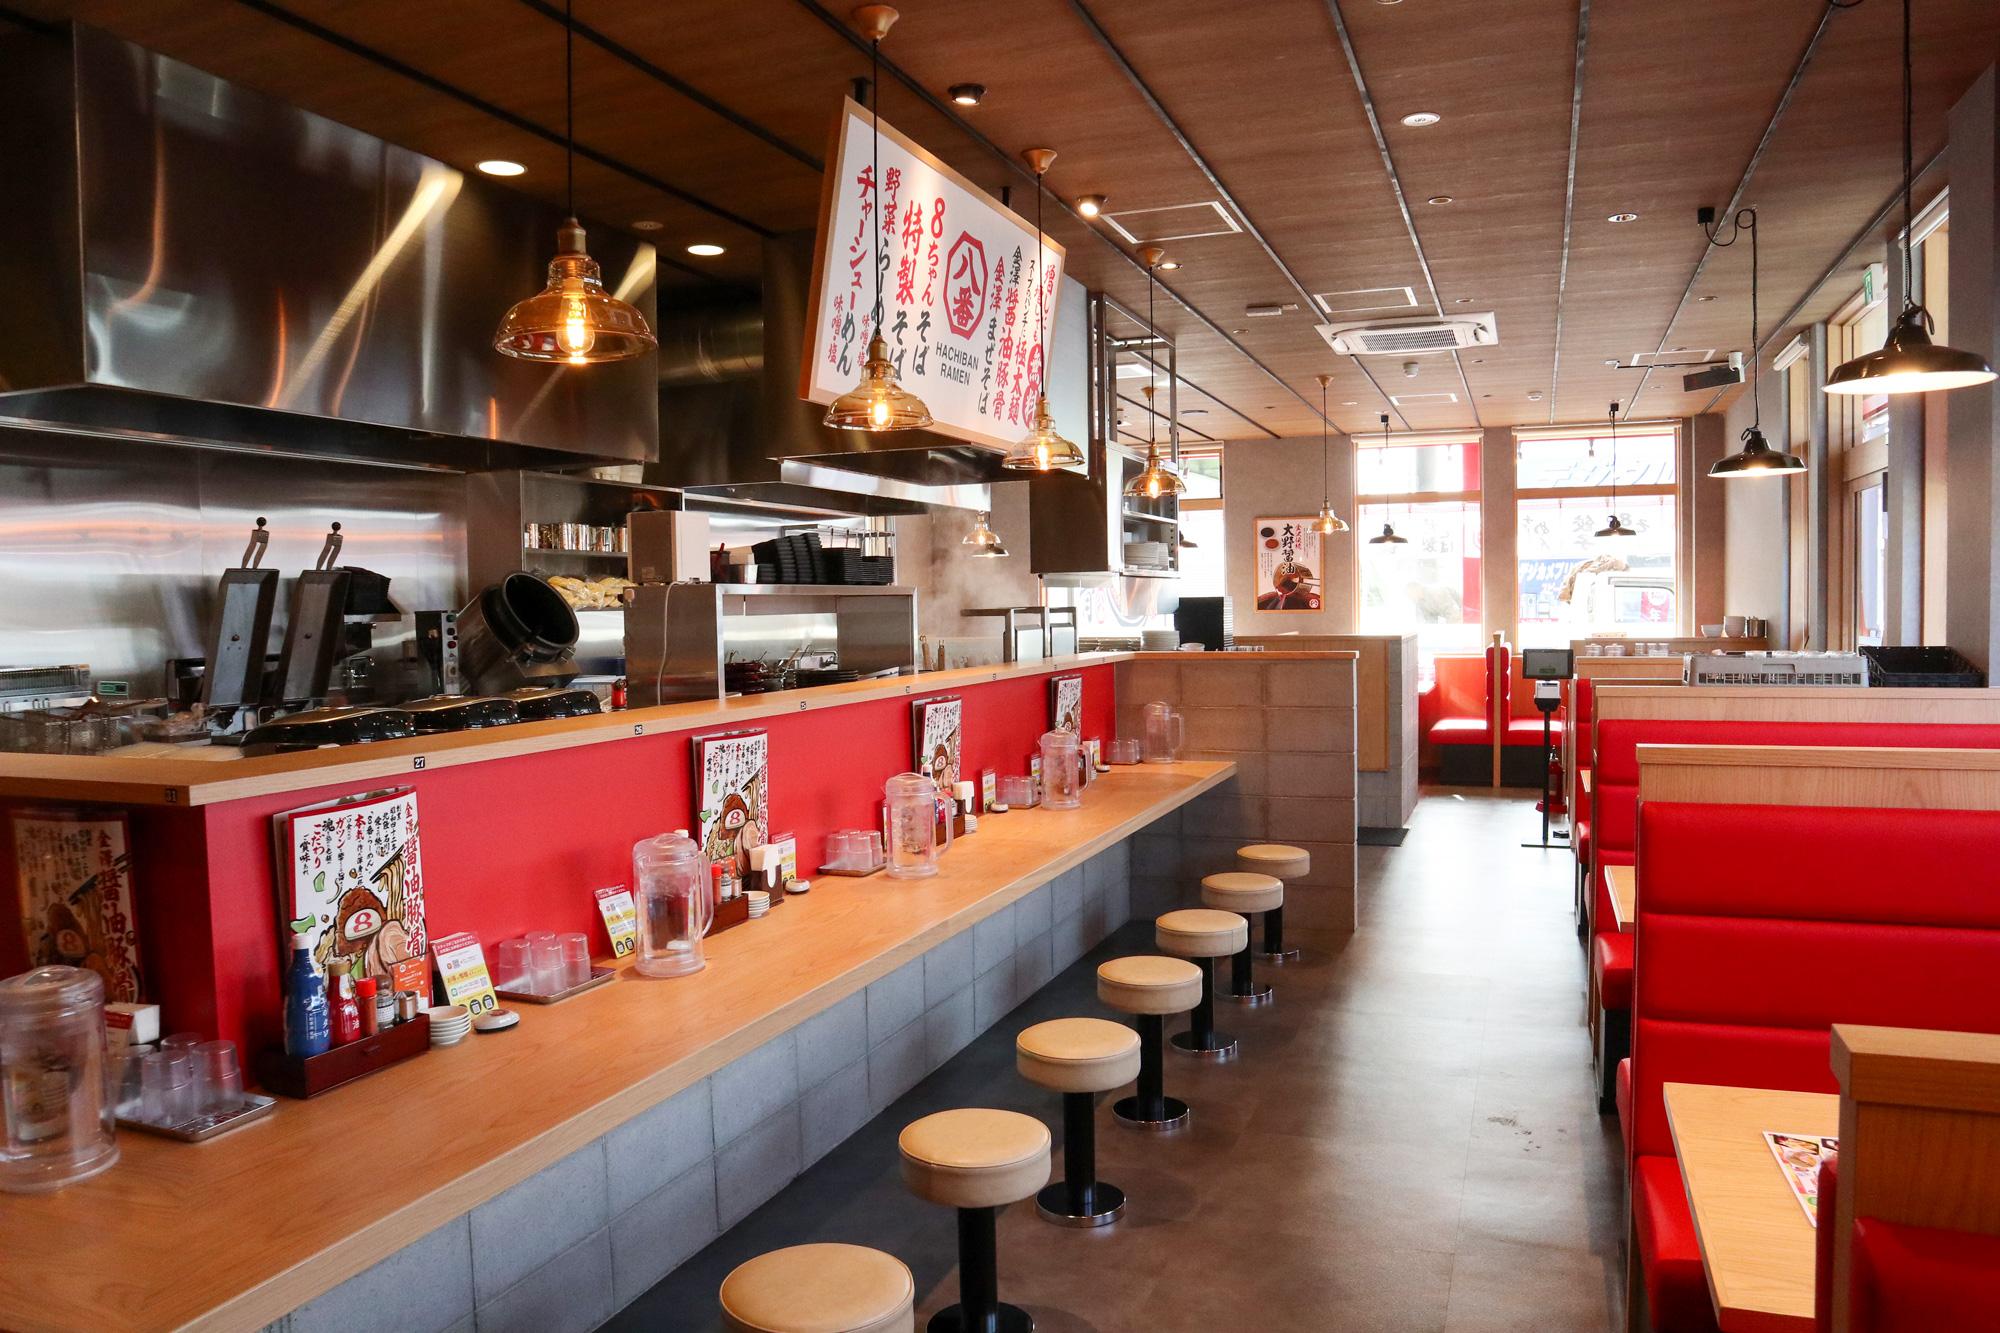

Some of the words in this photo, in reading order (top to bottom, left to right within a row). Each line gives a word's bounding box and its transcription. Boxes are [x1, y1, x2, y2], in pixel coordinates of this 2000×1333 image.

[952, 247, 982, 328] 八番
[935, 341, 979, 370] HACHIBAN
[940, 362, 970, 386] RAMEN
[415, 758, 424, 768] 27
[730, 811, 740, 824] 8
[311, 823, 325, 869] こだわり
[353, 912, 373, 933] 8
[62, 931, 75, 949] 8
